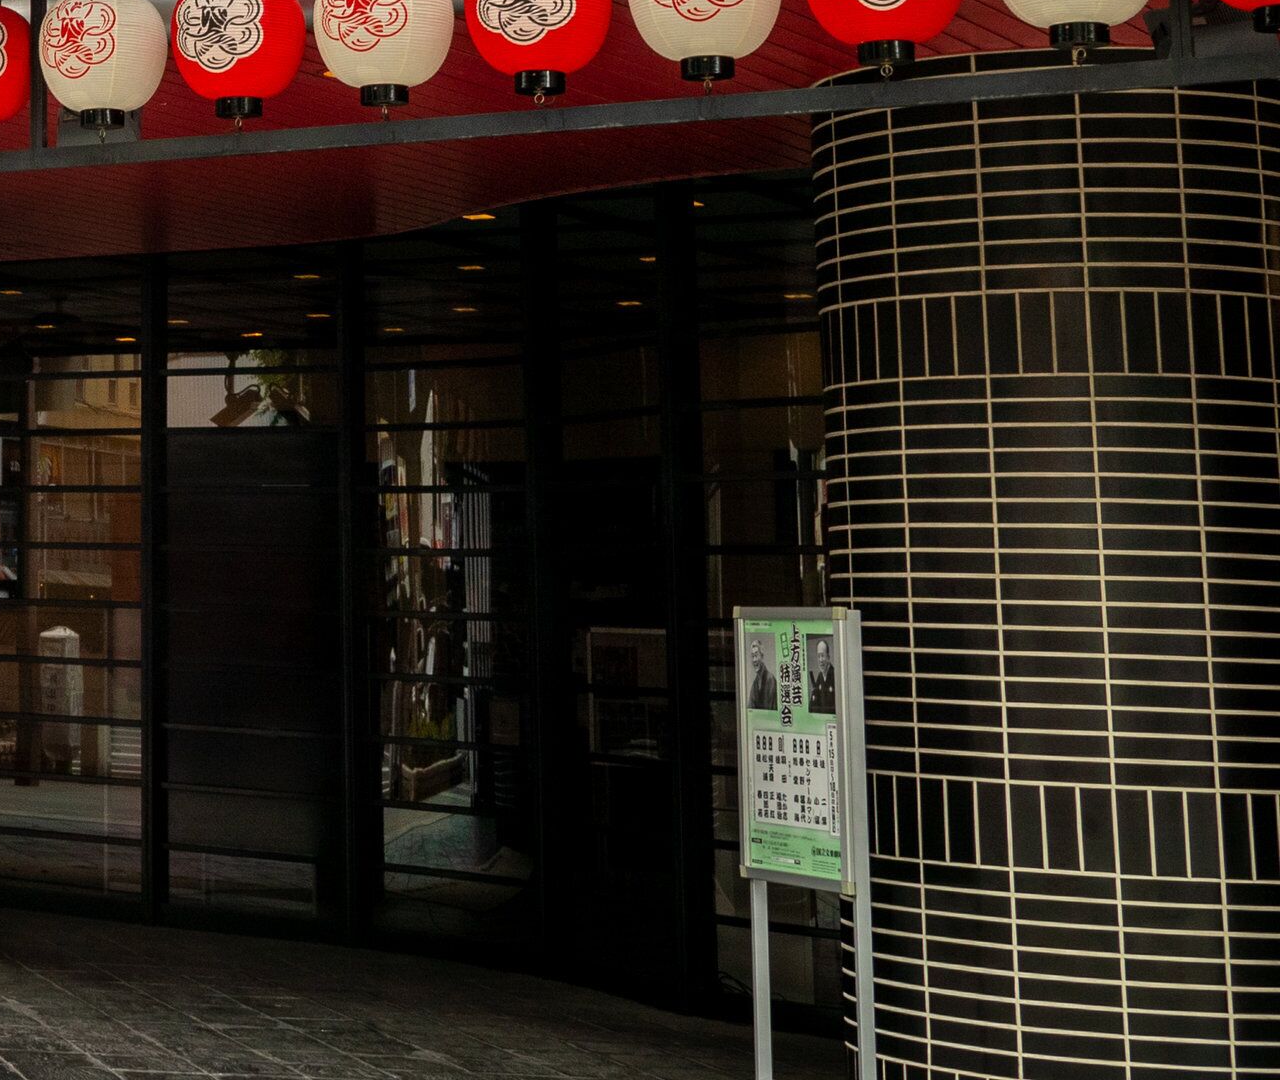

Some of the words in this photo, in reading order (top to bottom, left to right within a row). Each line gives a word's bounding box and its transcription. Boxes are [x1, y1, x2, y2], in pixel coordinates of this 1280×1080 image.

[779, 663, 793, 727] 特選会
[789, 623, 804, 706] 上方演芸
